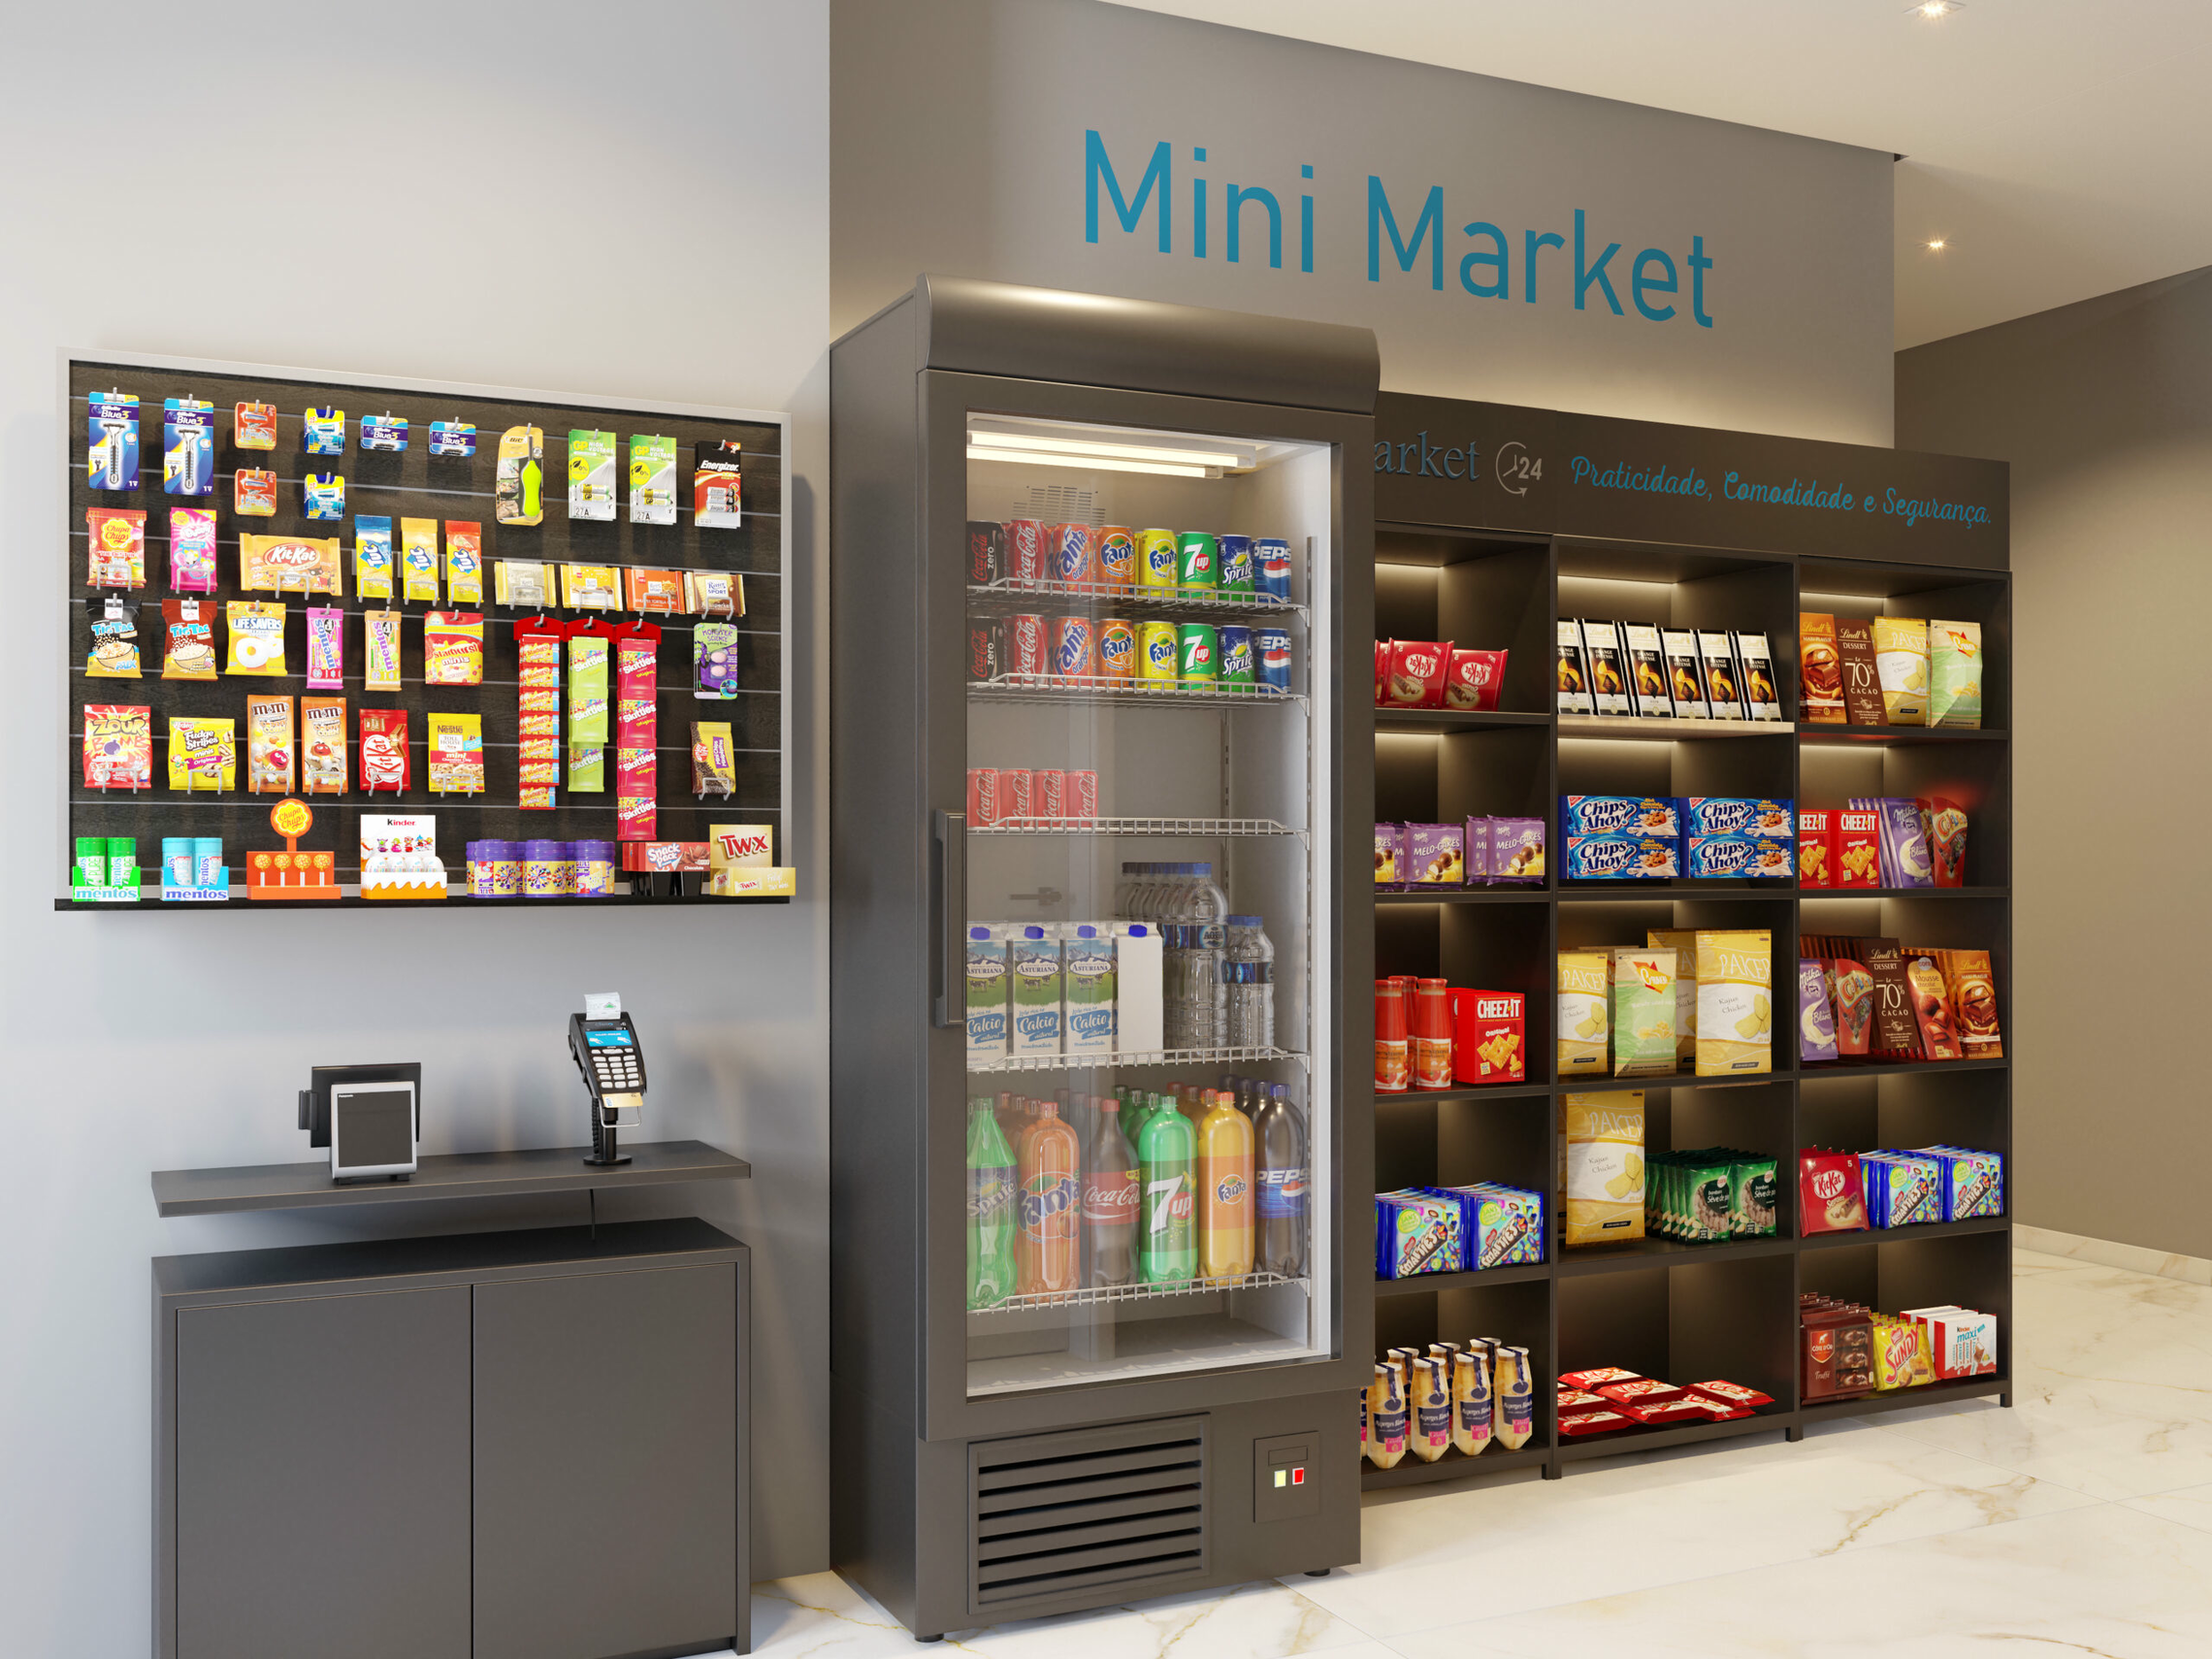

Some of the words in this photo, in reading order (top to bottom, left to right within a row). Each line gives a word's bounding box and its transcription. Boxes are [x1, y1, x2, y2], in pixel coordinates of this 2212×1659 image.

[1086, 129, 1314, 273] Mini
[1368, 175, 1713, 328] Market
[573, 440, 588, 450] GP
[635, 445, 649, 455] GP
[1375, 431, 1480, 481] arket
[1518, 457, 1542, 480] 24
[1572, 456, 1712, 502] Praticidade,
[1724, 471, 1855, 510] Comodidade
[1864, 494, 1876, 512] e
[1883, 487, 1991, 529] Segurança.
[105, 531, 129, 543] Chups
[271, 545, 316, 564] KitKat
[1054, 530, 1088, 588] Fanta
[1254, 546, 1291, 561] PEPS
[1072, 552, 1090, 579] orange
[1222, 564, 1252, 584] Sprite
[233, 618, 249, 630] LIFE
[250, 618, 282, 630] SAVERS
[1839, 628, 1861, 639] Lindt
[314, 619, 335, 668] mentos
[374, 622, 394, 670] mentos
[1254, 636, 1291, 650] PEPS
[1054, 624, 1088, 682] Fanta
[1072, 646, 1090, 673] orange
[573, 654, 607, 671] Skittles
[623, 655, 656, 673] Skittles
[1222, 655, 1252, 675] Sprite
[573, 702, 607, 721] Skittles
[623, 703, 656, 723] Skittles
[93, 717, 146, 735] ZOUR
[183, 730, 214, 741] Fudge
[186, 737, 219, 751] Stripes
[194, 748, 213, 758] minis
[367, 739, 402, 773] KitKat
[570, 752, 603, 771] Skittles
[623, 752, 656, 771] Skittles
[278, 806, 301, 820] Chupa
[624, 800, 656, 820] Skittles
[1580, 800, 1628, 818] Chips
[1581, 805, 1635, 830] Ahoy!
[1701, 801, 1744, 819] Chips
[1893, 806, 1917, 822] Milka
[281, 813, 305, 830] Chups
[1703, 806, 1753, 831] Ahoy!
[1800, 814, 1828, 830] EEZ-IT
[647, 843, 681, 860] Snack
[1580, 841, 1628, 859] Chips
[1581, 846, 1635, 872] Ahoy!
[1701, 842, 1744, 859] Chips
[1703, 847, 1753, 872] Ahoy!
[76, 888, 137, 899] mentos
[166, 889, 227, 899] mentos
[1871, 948, 1891, 960] Lindt
[1019, 964, 1057, 973] ASTURIANA
[1072, 963, 1108, 972] ASTURIANA
[1962, 960, 1980, 969] Lindt
[967, 1018, 1001, 1034] Calcio
[1020, 1016, 1055, 1033] Calcio
[1073, 1014, 1106, 1031] Calcio
[1256, 1168, 1309, 1184] PEPS
[1817, 1173, 1841, 1195] KitKat
[967, 1181, 1017, 1218] Sprite
[1218, 1181, 1247, 1203] Fanta
[1020, 1177, 1080, 1231] Fanta
[1957, 1326, 1976, 1343] maxi
[1885, 1325, 1919, 1383] SUNDY
